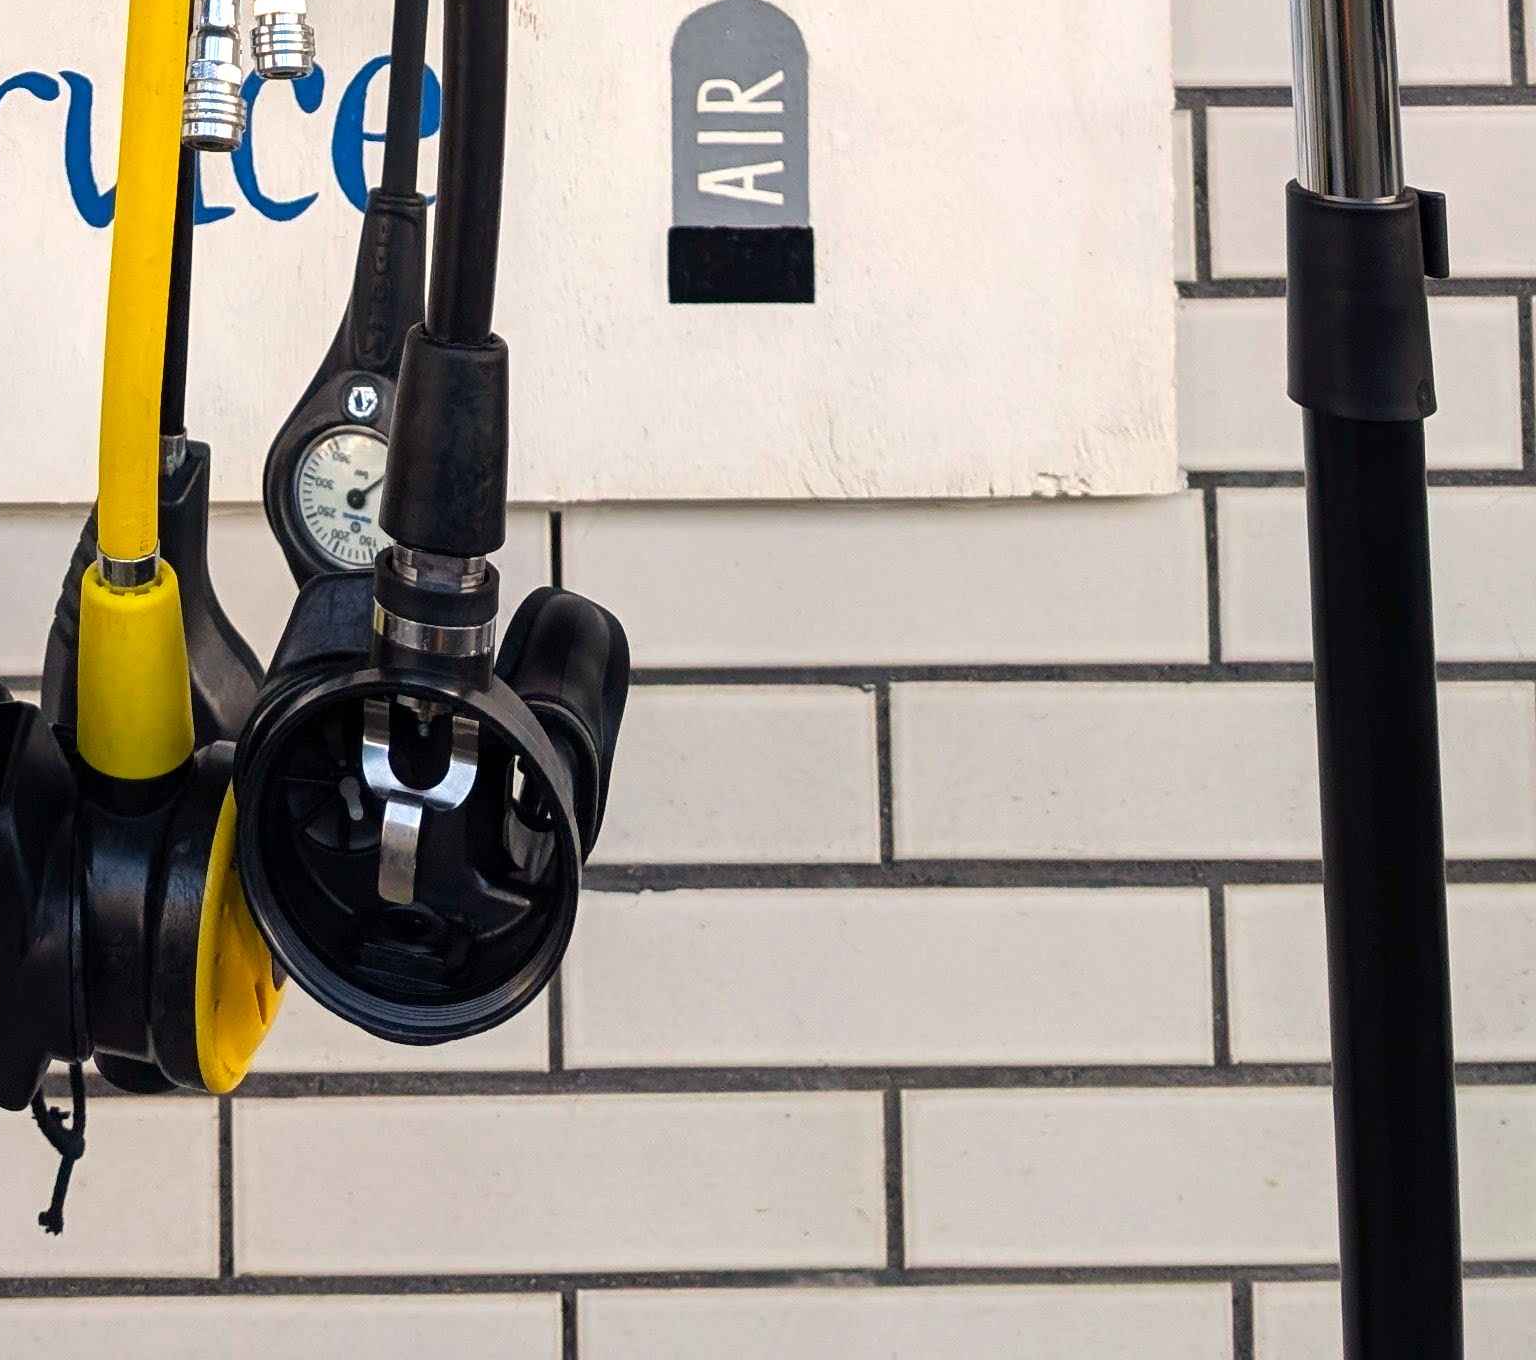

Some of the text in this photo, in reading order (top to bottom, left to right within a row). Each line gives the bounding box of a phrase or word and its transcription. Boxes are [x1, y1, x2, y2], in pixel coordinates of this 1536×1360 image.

[696, 69, 785, 206] AIR
[315, 477, 334, 491] 300
[317, 504, 336, 519] 250
[330, 528, 350, 542] 200
